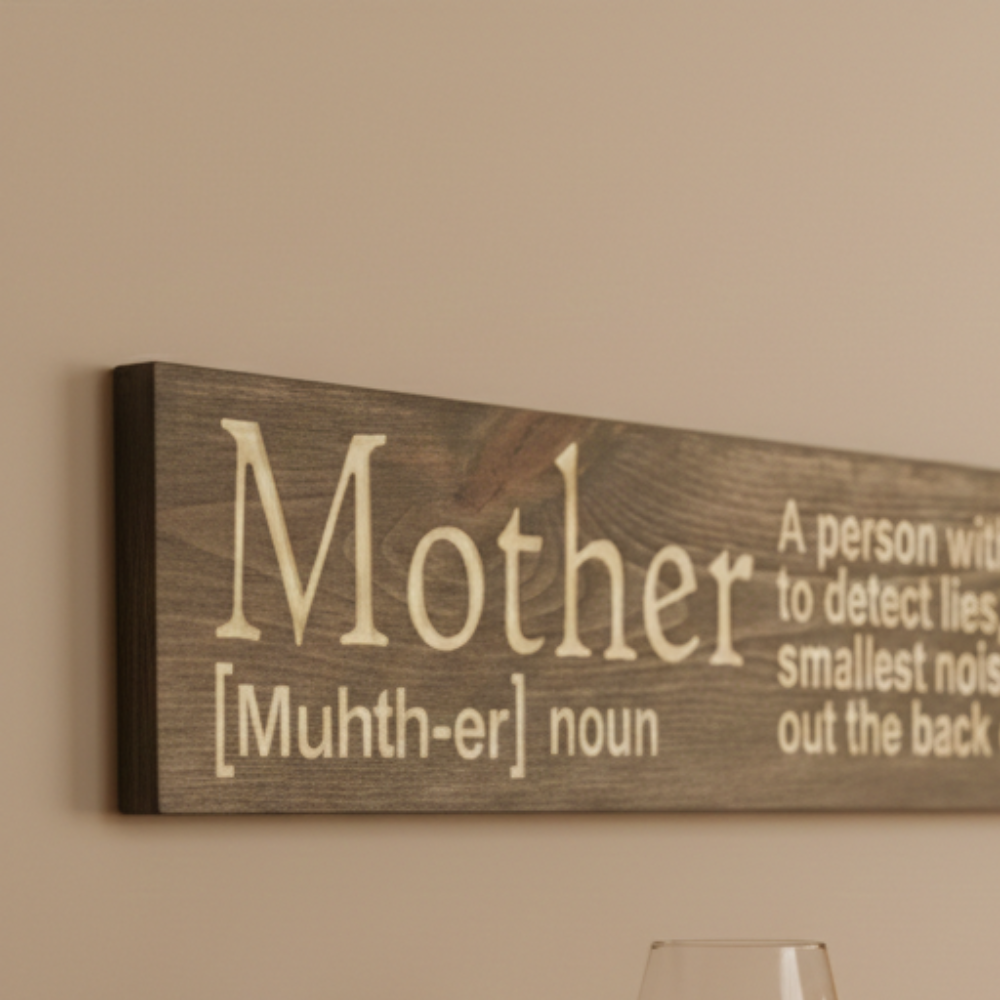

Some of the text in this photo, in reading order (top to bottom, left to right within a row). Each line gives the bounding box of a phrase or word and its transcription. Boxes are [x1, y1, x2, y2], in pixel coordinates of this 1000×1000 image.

[215, 417, 754, 667] Mother
[778, 499, 806, 553] A
[817, 513, 938, 571] person
[776, 565, 814, 623] to
[823, 566, 933, 630] detect
[777, 634, 928, 693] smallest
[215, 662, 659, 779] [Muhth-er] noun
[778, 700, 837, 755] out
[846, 699, 902, 756] the
[911, 700, 993, 758] back
